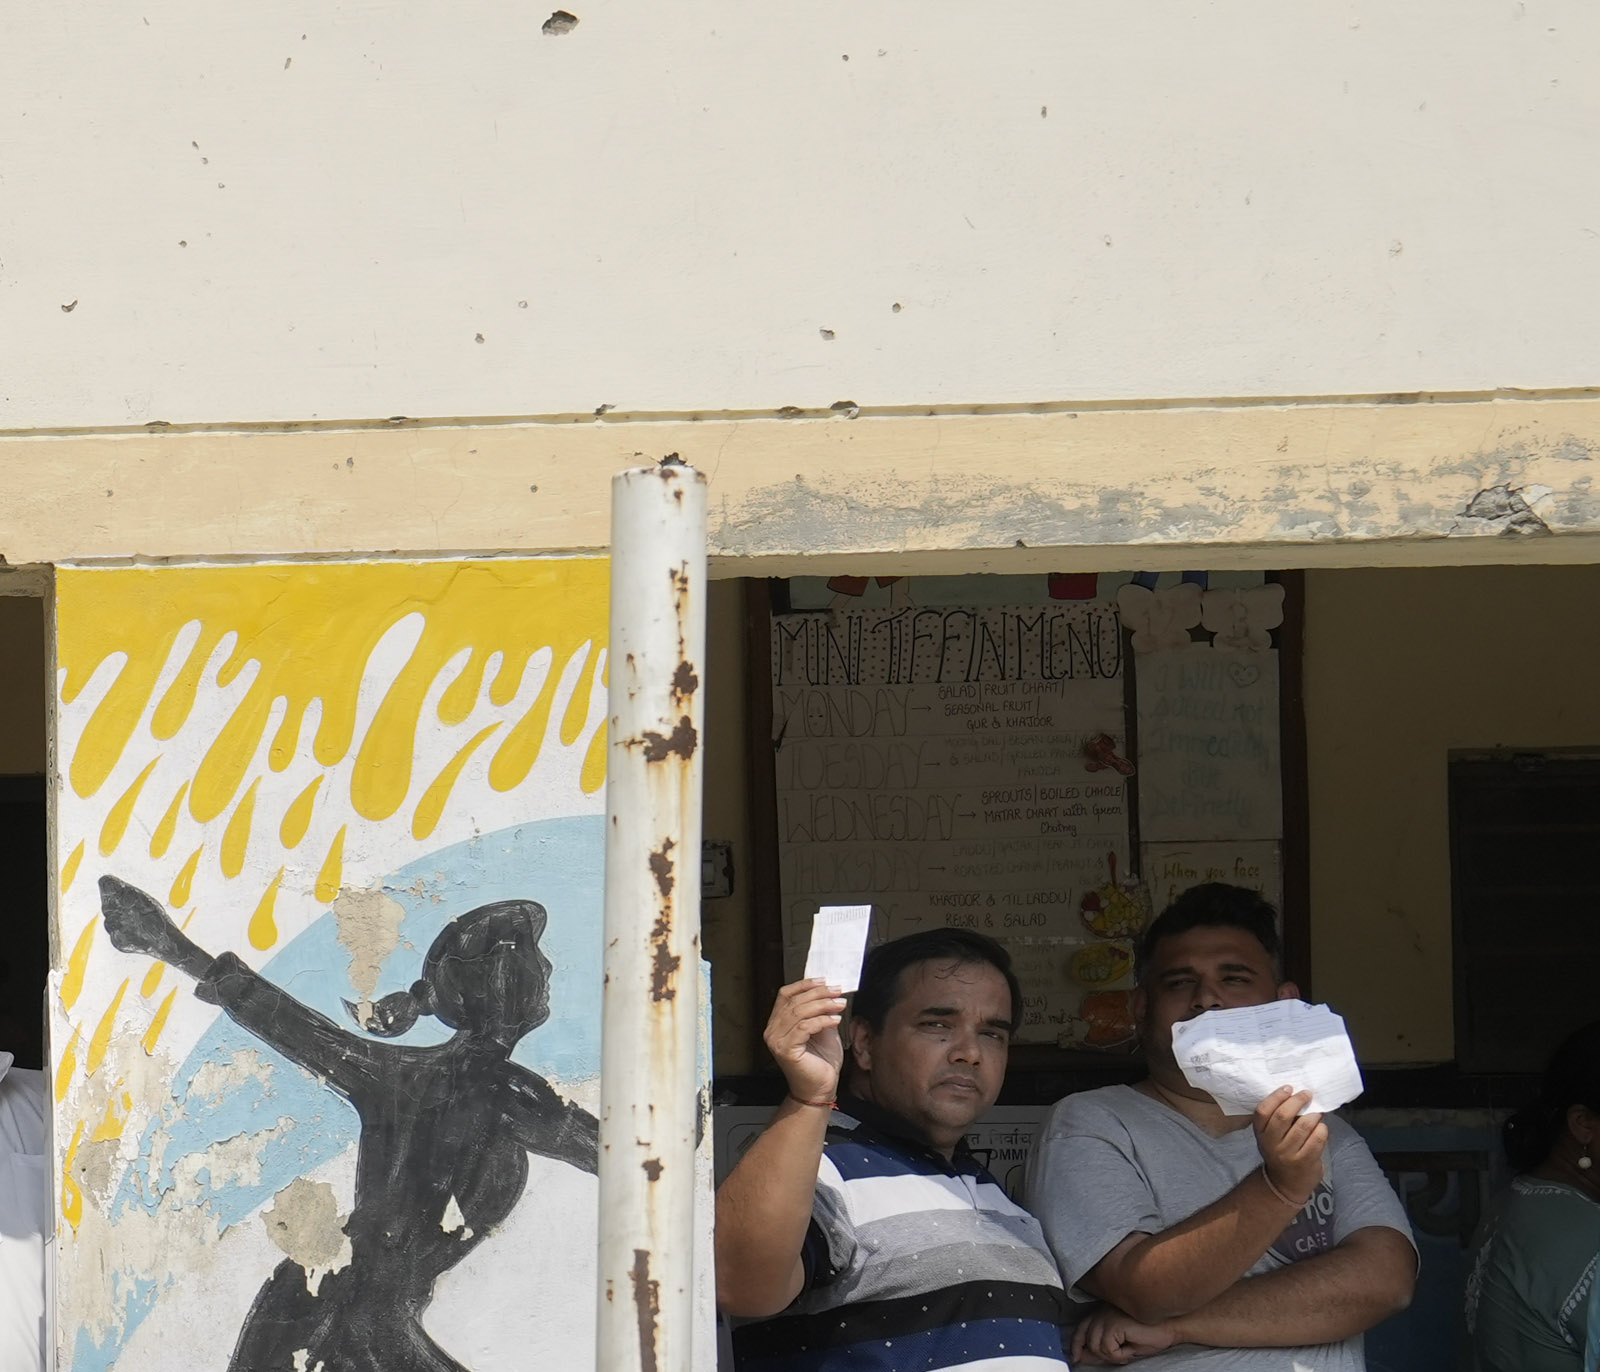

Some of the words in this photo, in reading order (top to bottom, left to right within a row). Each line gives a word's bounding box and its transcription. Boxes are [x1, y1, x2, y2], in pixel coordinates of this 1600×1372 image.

[776, 616, 862, 686] MINI
[872, 608, 1007, 684] TIFFIN
[1017, 611, 1122, 681] MENU
[780, 688, 915, 738] MONDAY
[944, 700, 999, 716] SEASONAL
[1040, 785, 1080, 801] BOILED
[783, 793, 961, 843] WEDNESDAY
[1163, 862, 1199, 879] When
[1002, 913, 1047, 927] SALAD
